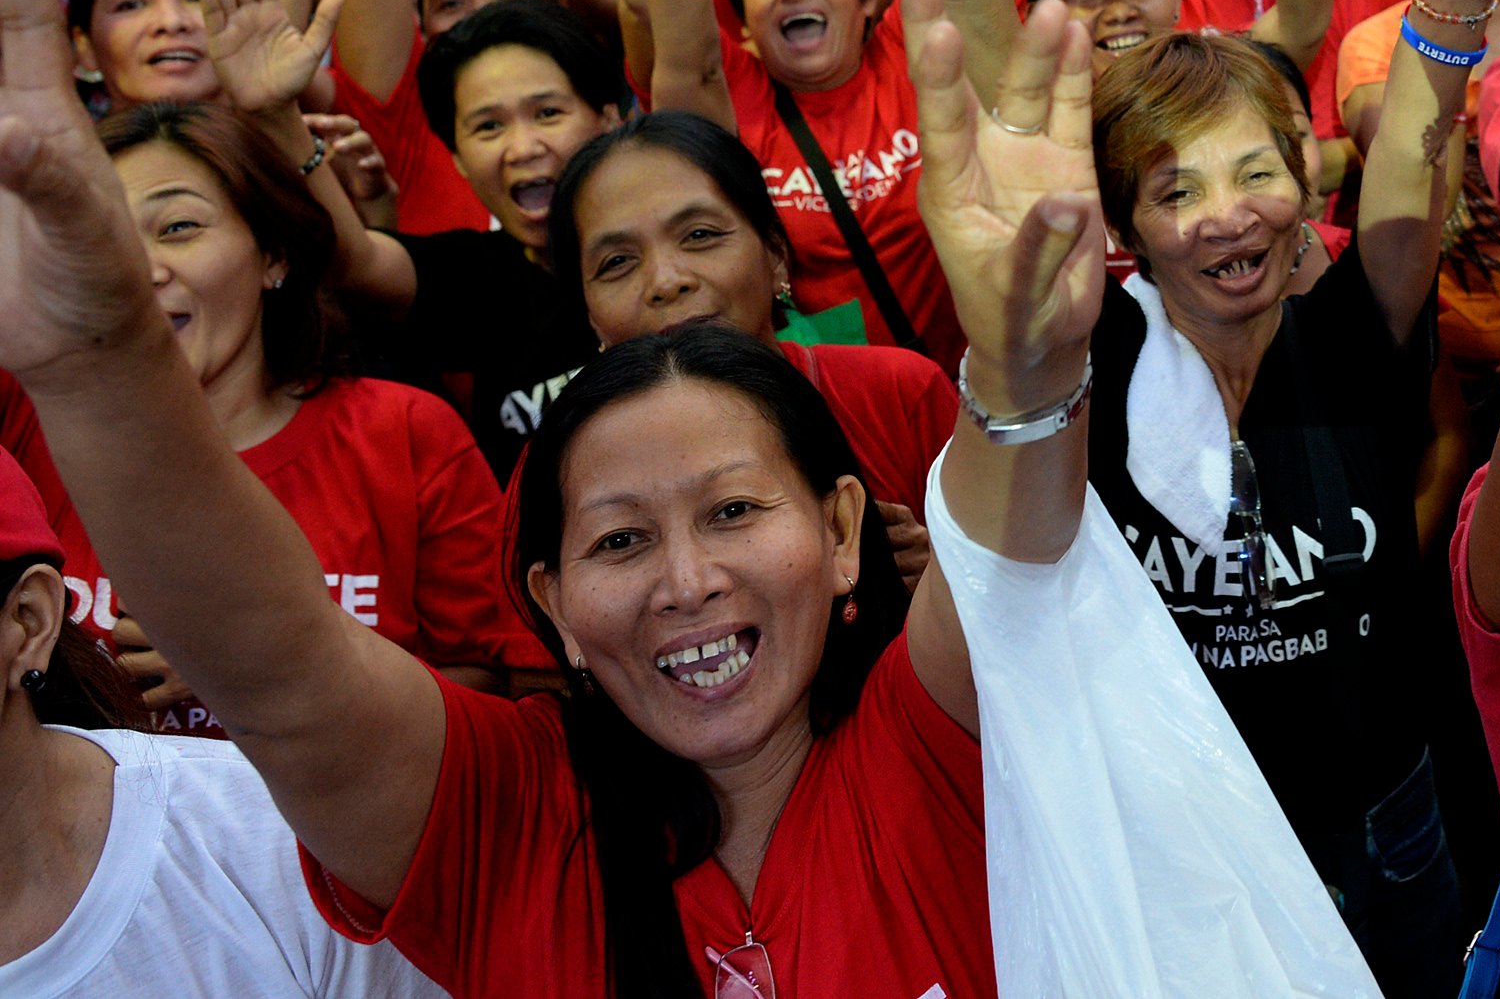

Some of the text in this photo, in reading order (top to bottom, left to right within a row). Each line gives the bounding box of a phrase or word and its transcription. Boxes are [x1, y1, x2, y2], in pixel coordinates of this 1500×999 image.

[1417, 41, 1470, 65] DUTERTE
[1215, 618, 1282, 643] PARA SA
